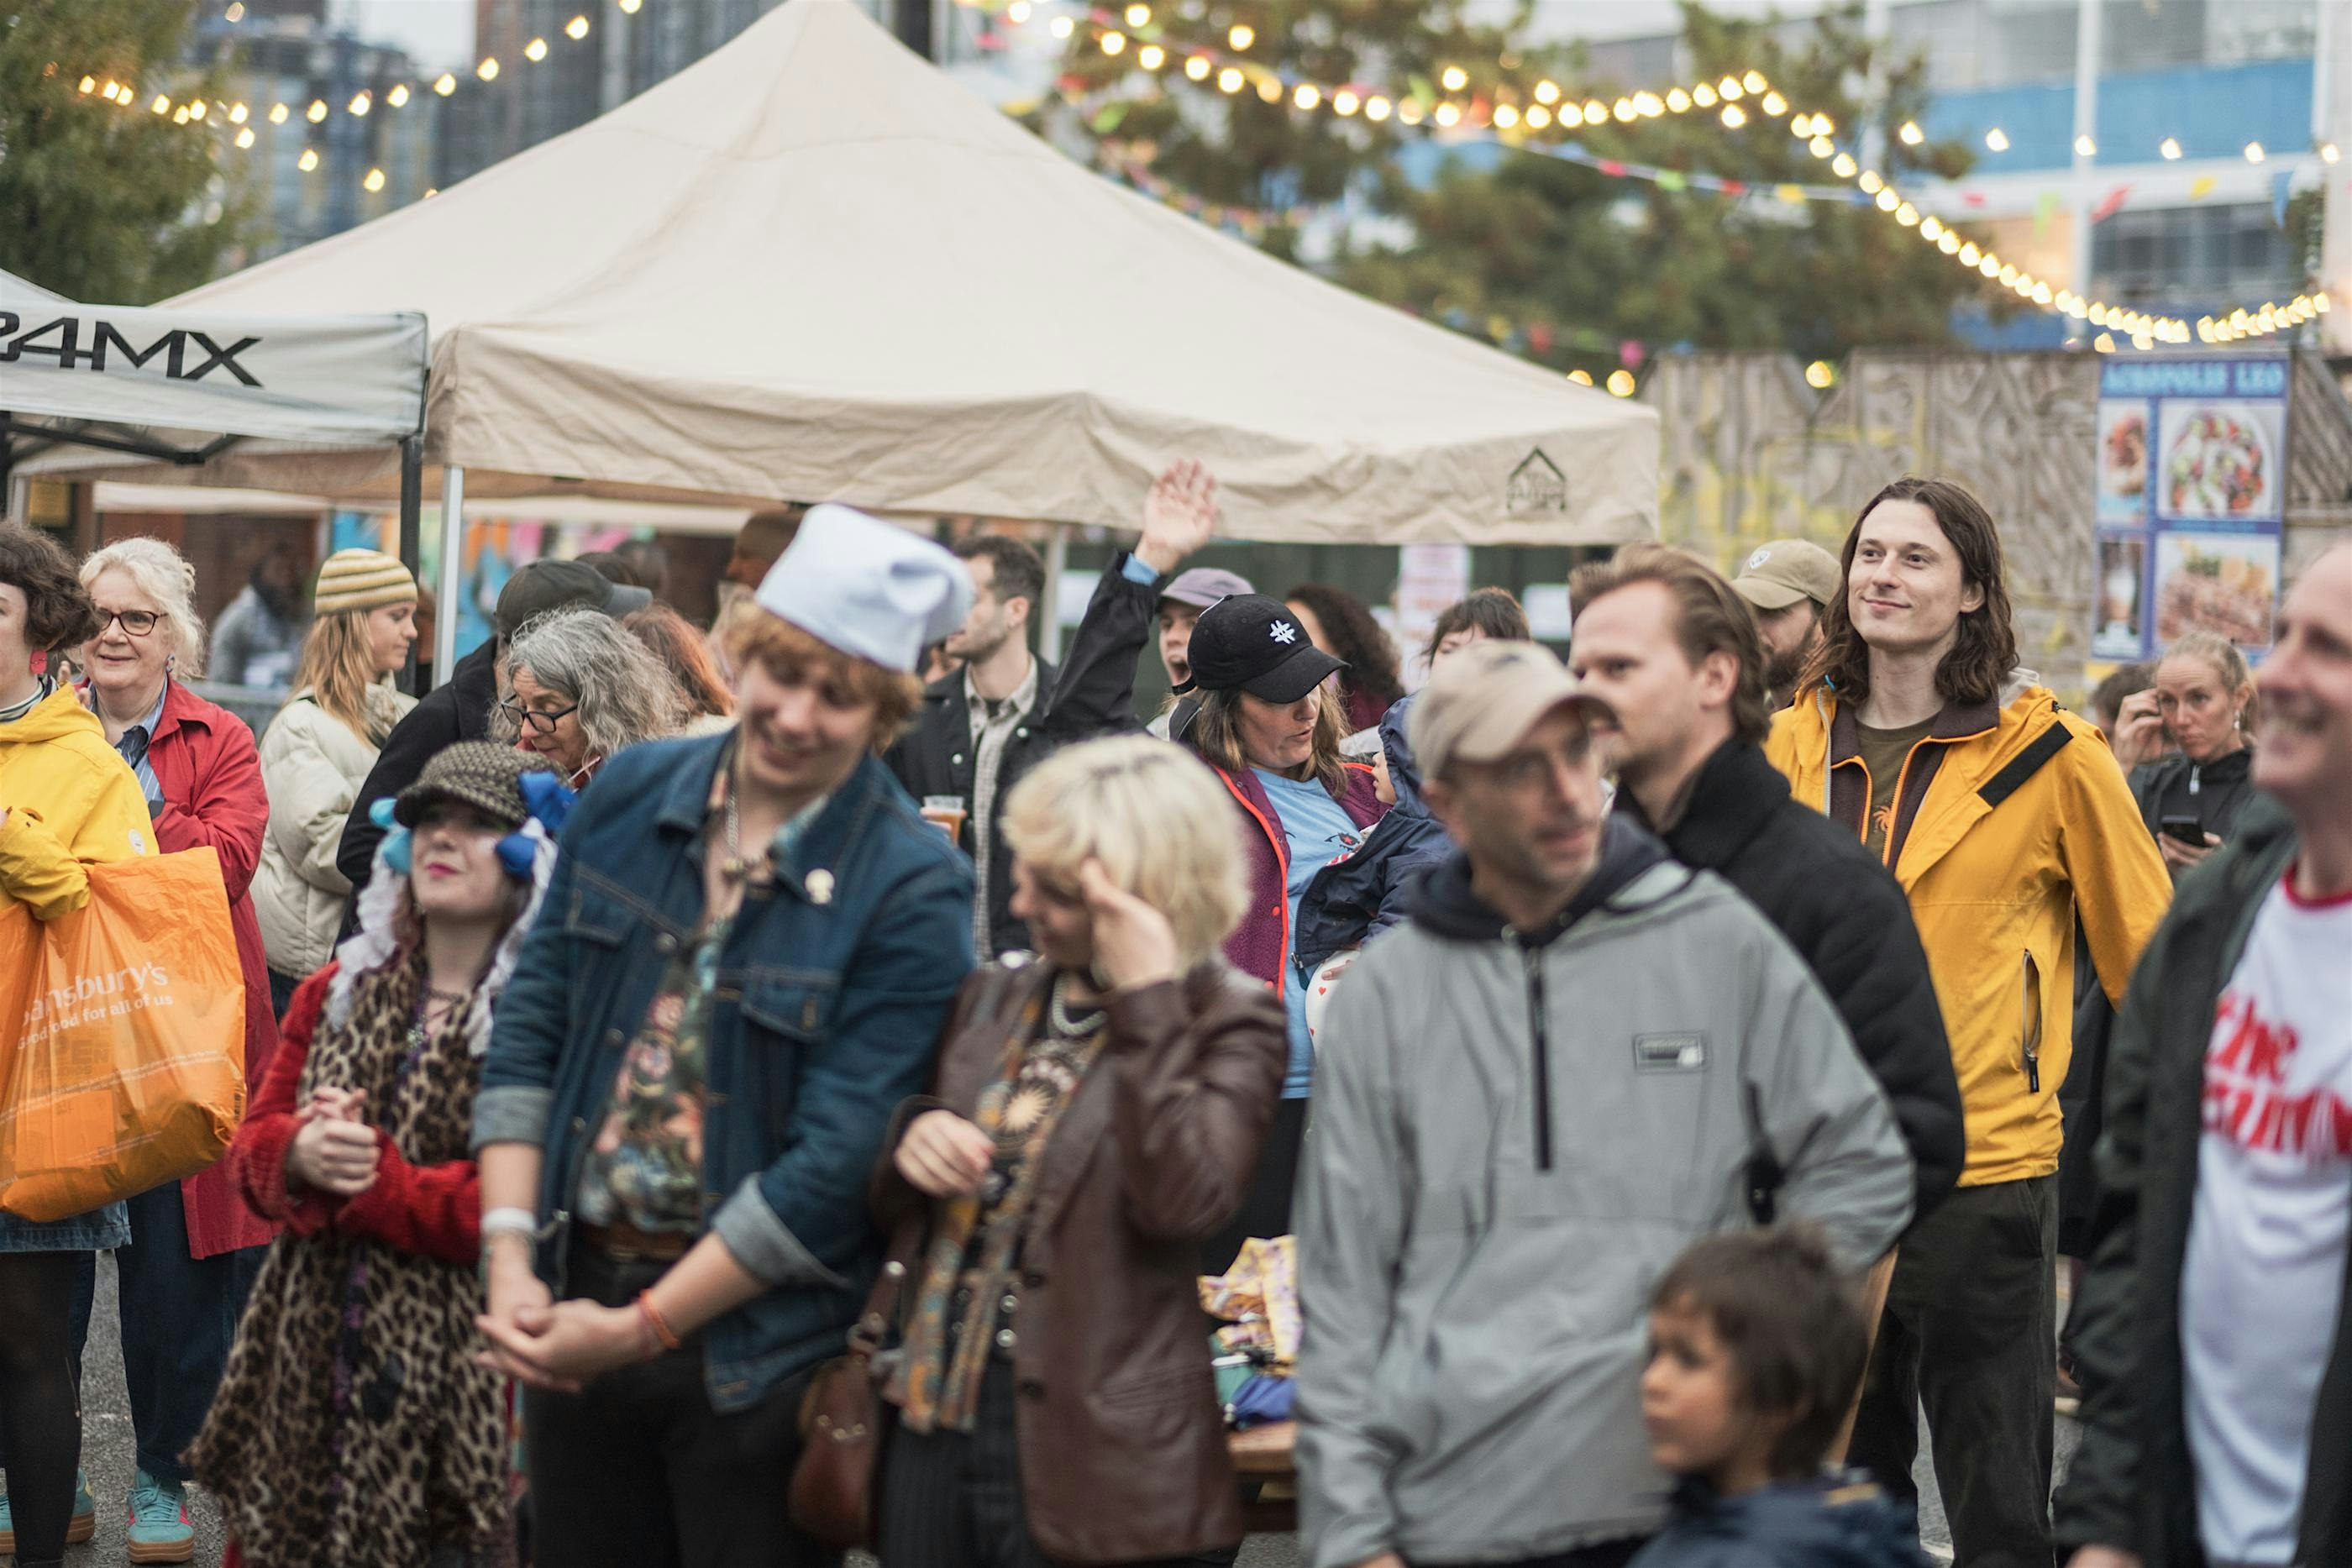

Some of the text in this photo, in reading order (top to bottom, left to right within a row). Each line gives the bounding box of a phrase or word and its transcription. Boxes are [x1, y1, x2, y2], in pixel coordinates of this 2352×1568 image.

[23, 962, 168, 1025] ainsbury's
[50, 1013, 80, 1034] ood
[82, 1006, 107, 1022] for
[110, 999, 132, 1016] all
[134, 993, 150, 1009] of
[153, 994, 173, 1006] us
